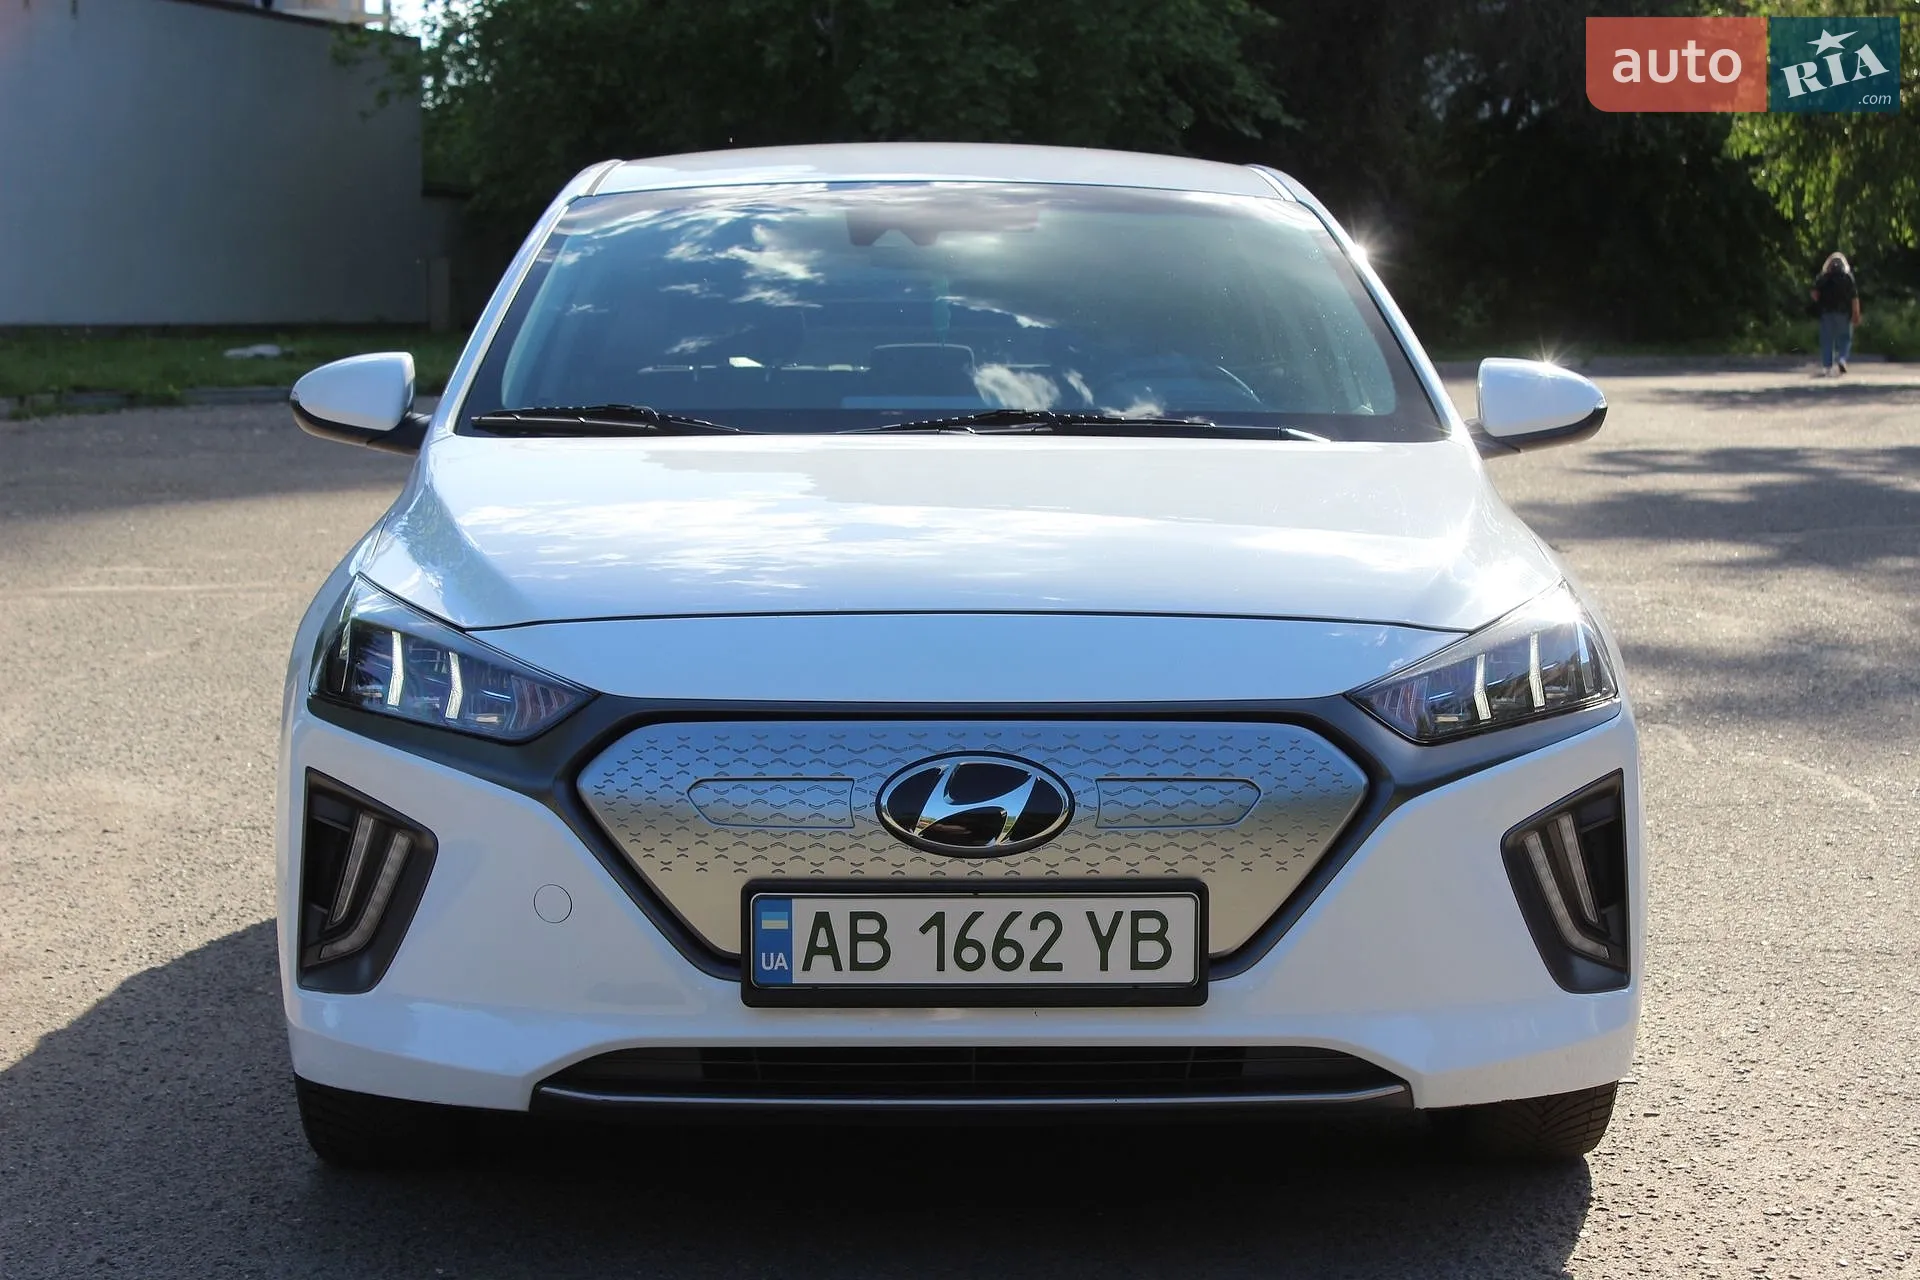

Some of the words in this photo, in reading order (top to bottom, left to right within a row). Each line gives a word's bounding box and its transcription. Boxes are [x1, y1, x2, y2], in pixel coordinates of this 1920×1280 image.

[761, 952, 788, 971] UA
[801, 911, 892, 972] AB
[918, 911, 1064, 972] 1662
[1085, 911, 1173, 972] YB
